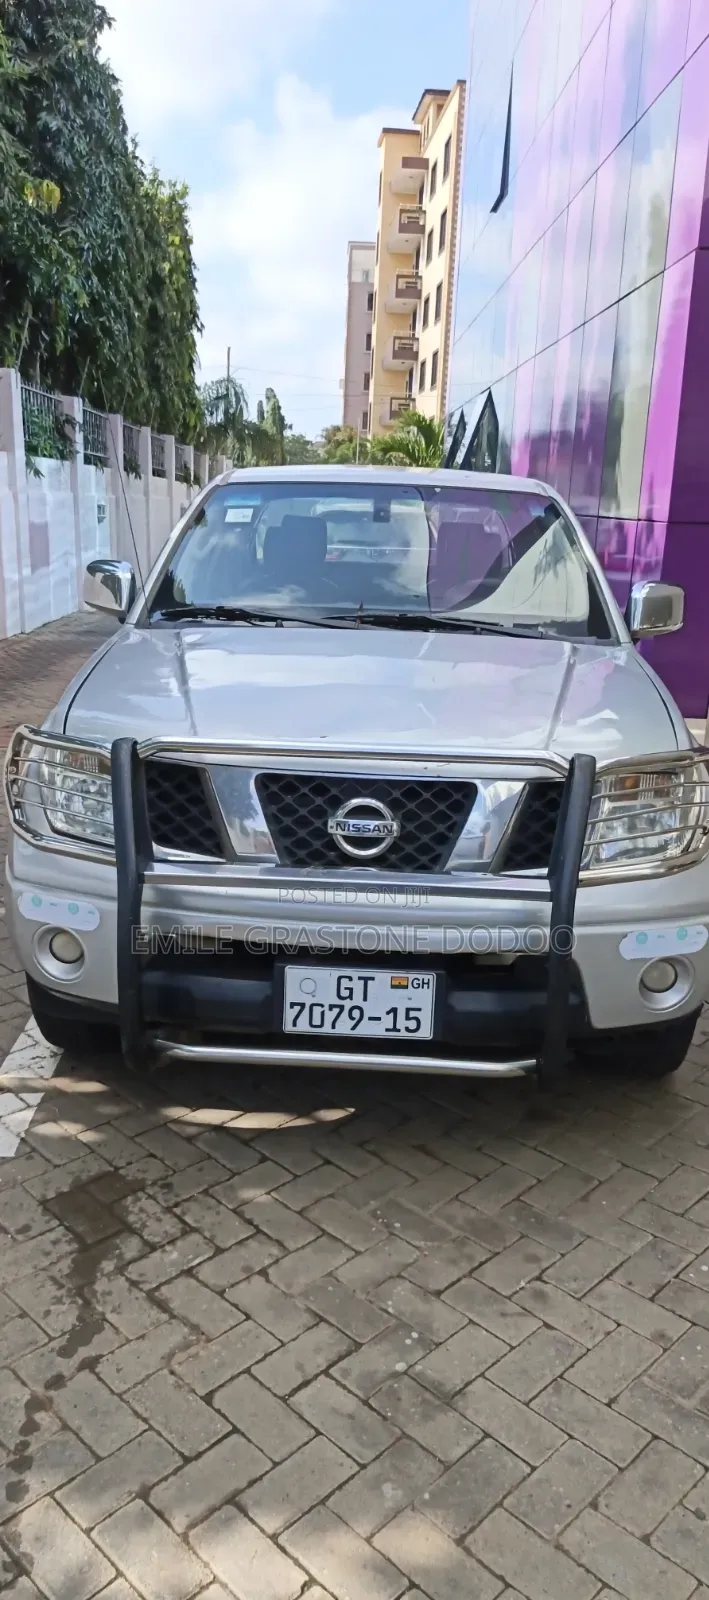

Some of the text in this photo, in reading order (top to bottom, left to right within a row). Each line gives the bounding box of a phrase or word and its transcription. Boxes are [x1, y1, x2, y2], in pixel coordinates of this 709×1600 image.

[335, 822, 394, 835] NISSAN
[336, 975, 375, 1002] GT
[411, 977, 430, 989] GH
[289, 1002, 422, 1033] 7079-15
